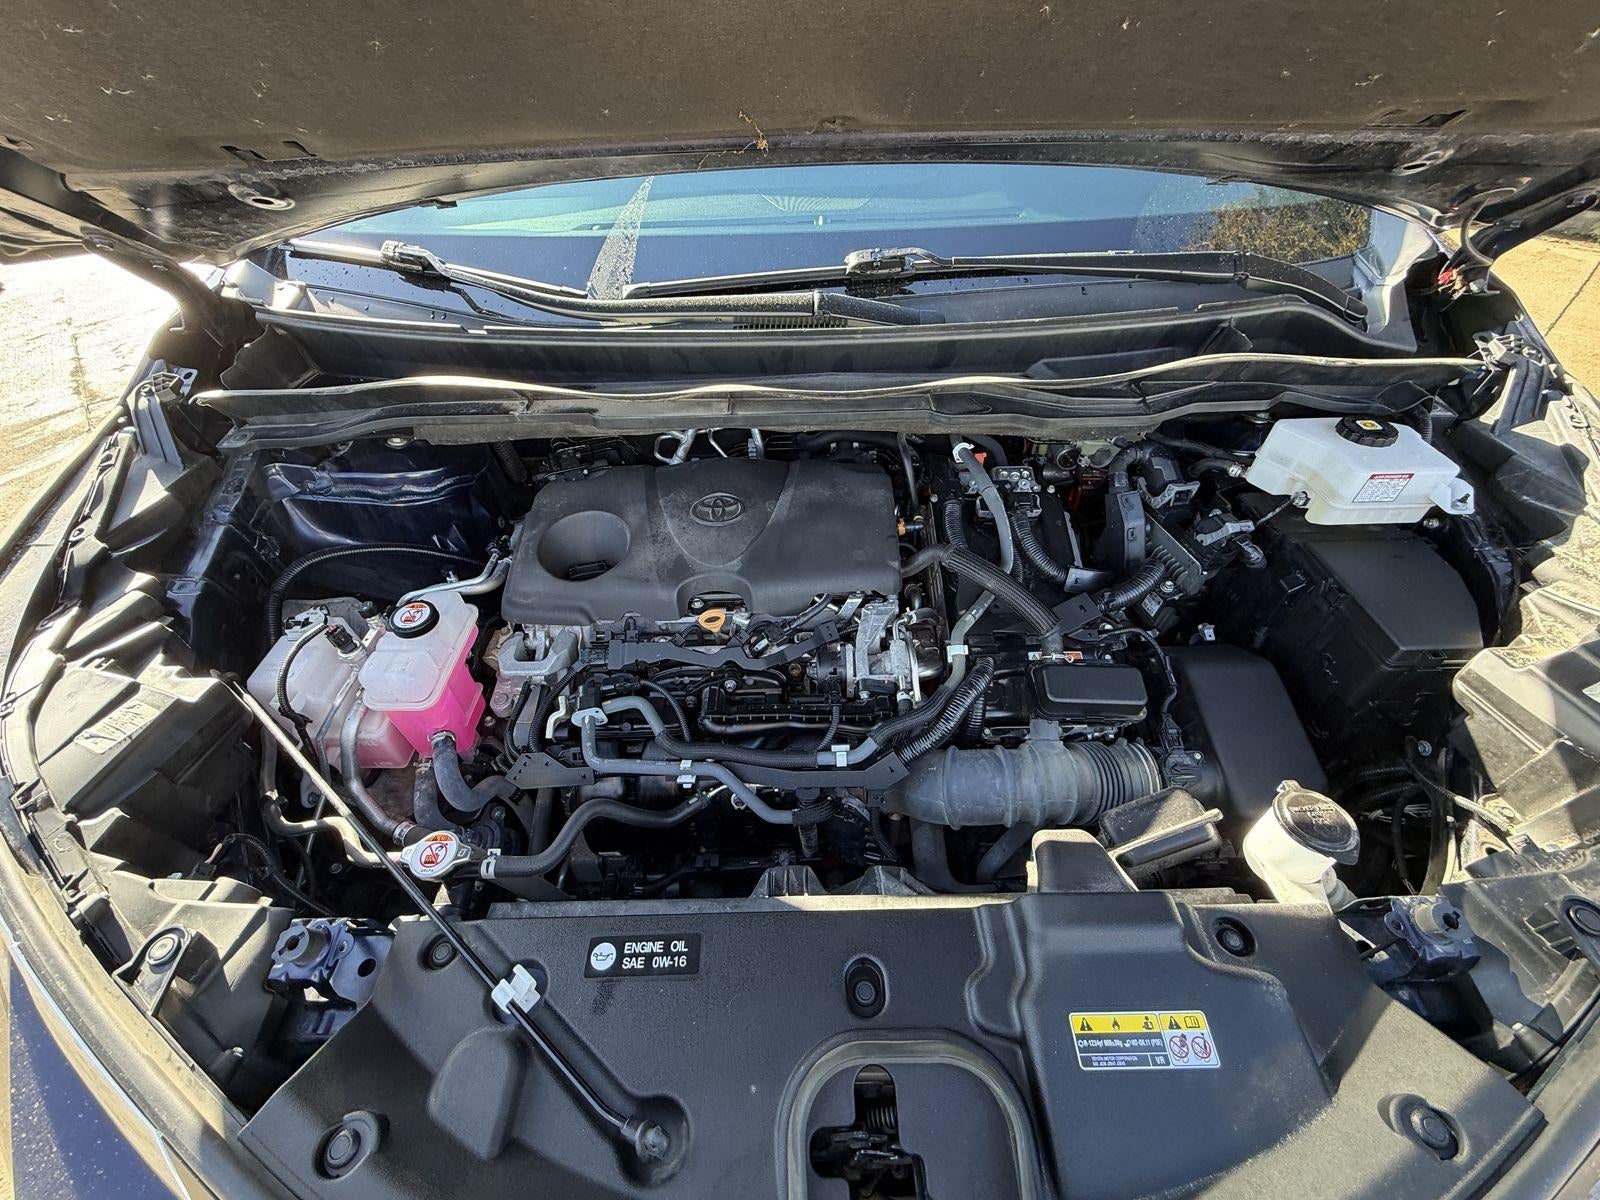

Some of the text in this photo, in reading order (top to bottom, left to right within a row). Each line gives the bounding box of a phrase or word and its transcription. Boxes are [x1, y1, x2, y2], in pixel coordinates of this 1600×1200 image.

[624, 940, 688, 954] ENGINE OIL
[621, 955, 687, 969] SAE 0W-16
